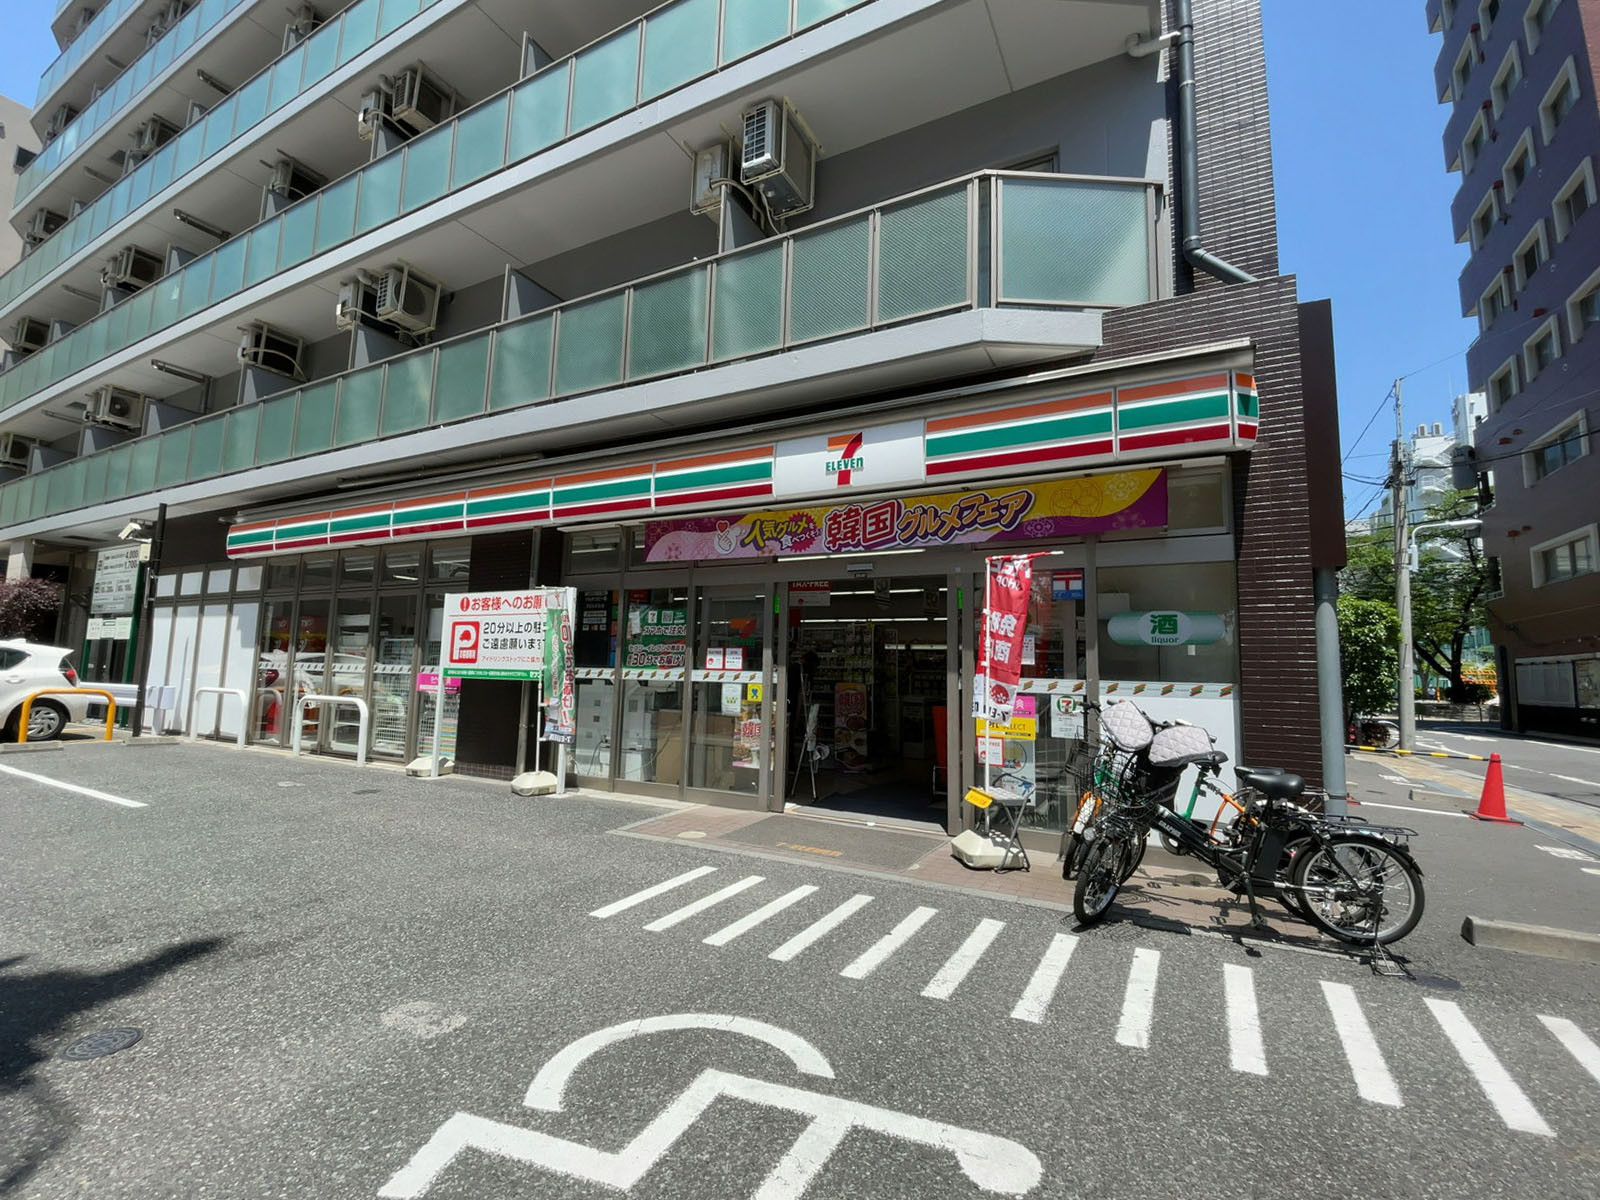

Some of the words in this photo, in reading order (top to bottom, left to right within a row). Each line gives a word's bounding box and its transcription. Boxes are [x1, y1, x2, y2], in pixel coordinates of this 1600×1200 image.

[827, 431, 863, 486] 7
[1150, 614, 1178, 635] 酒
[1151, 635, 1179, 645] liquor
